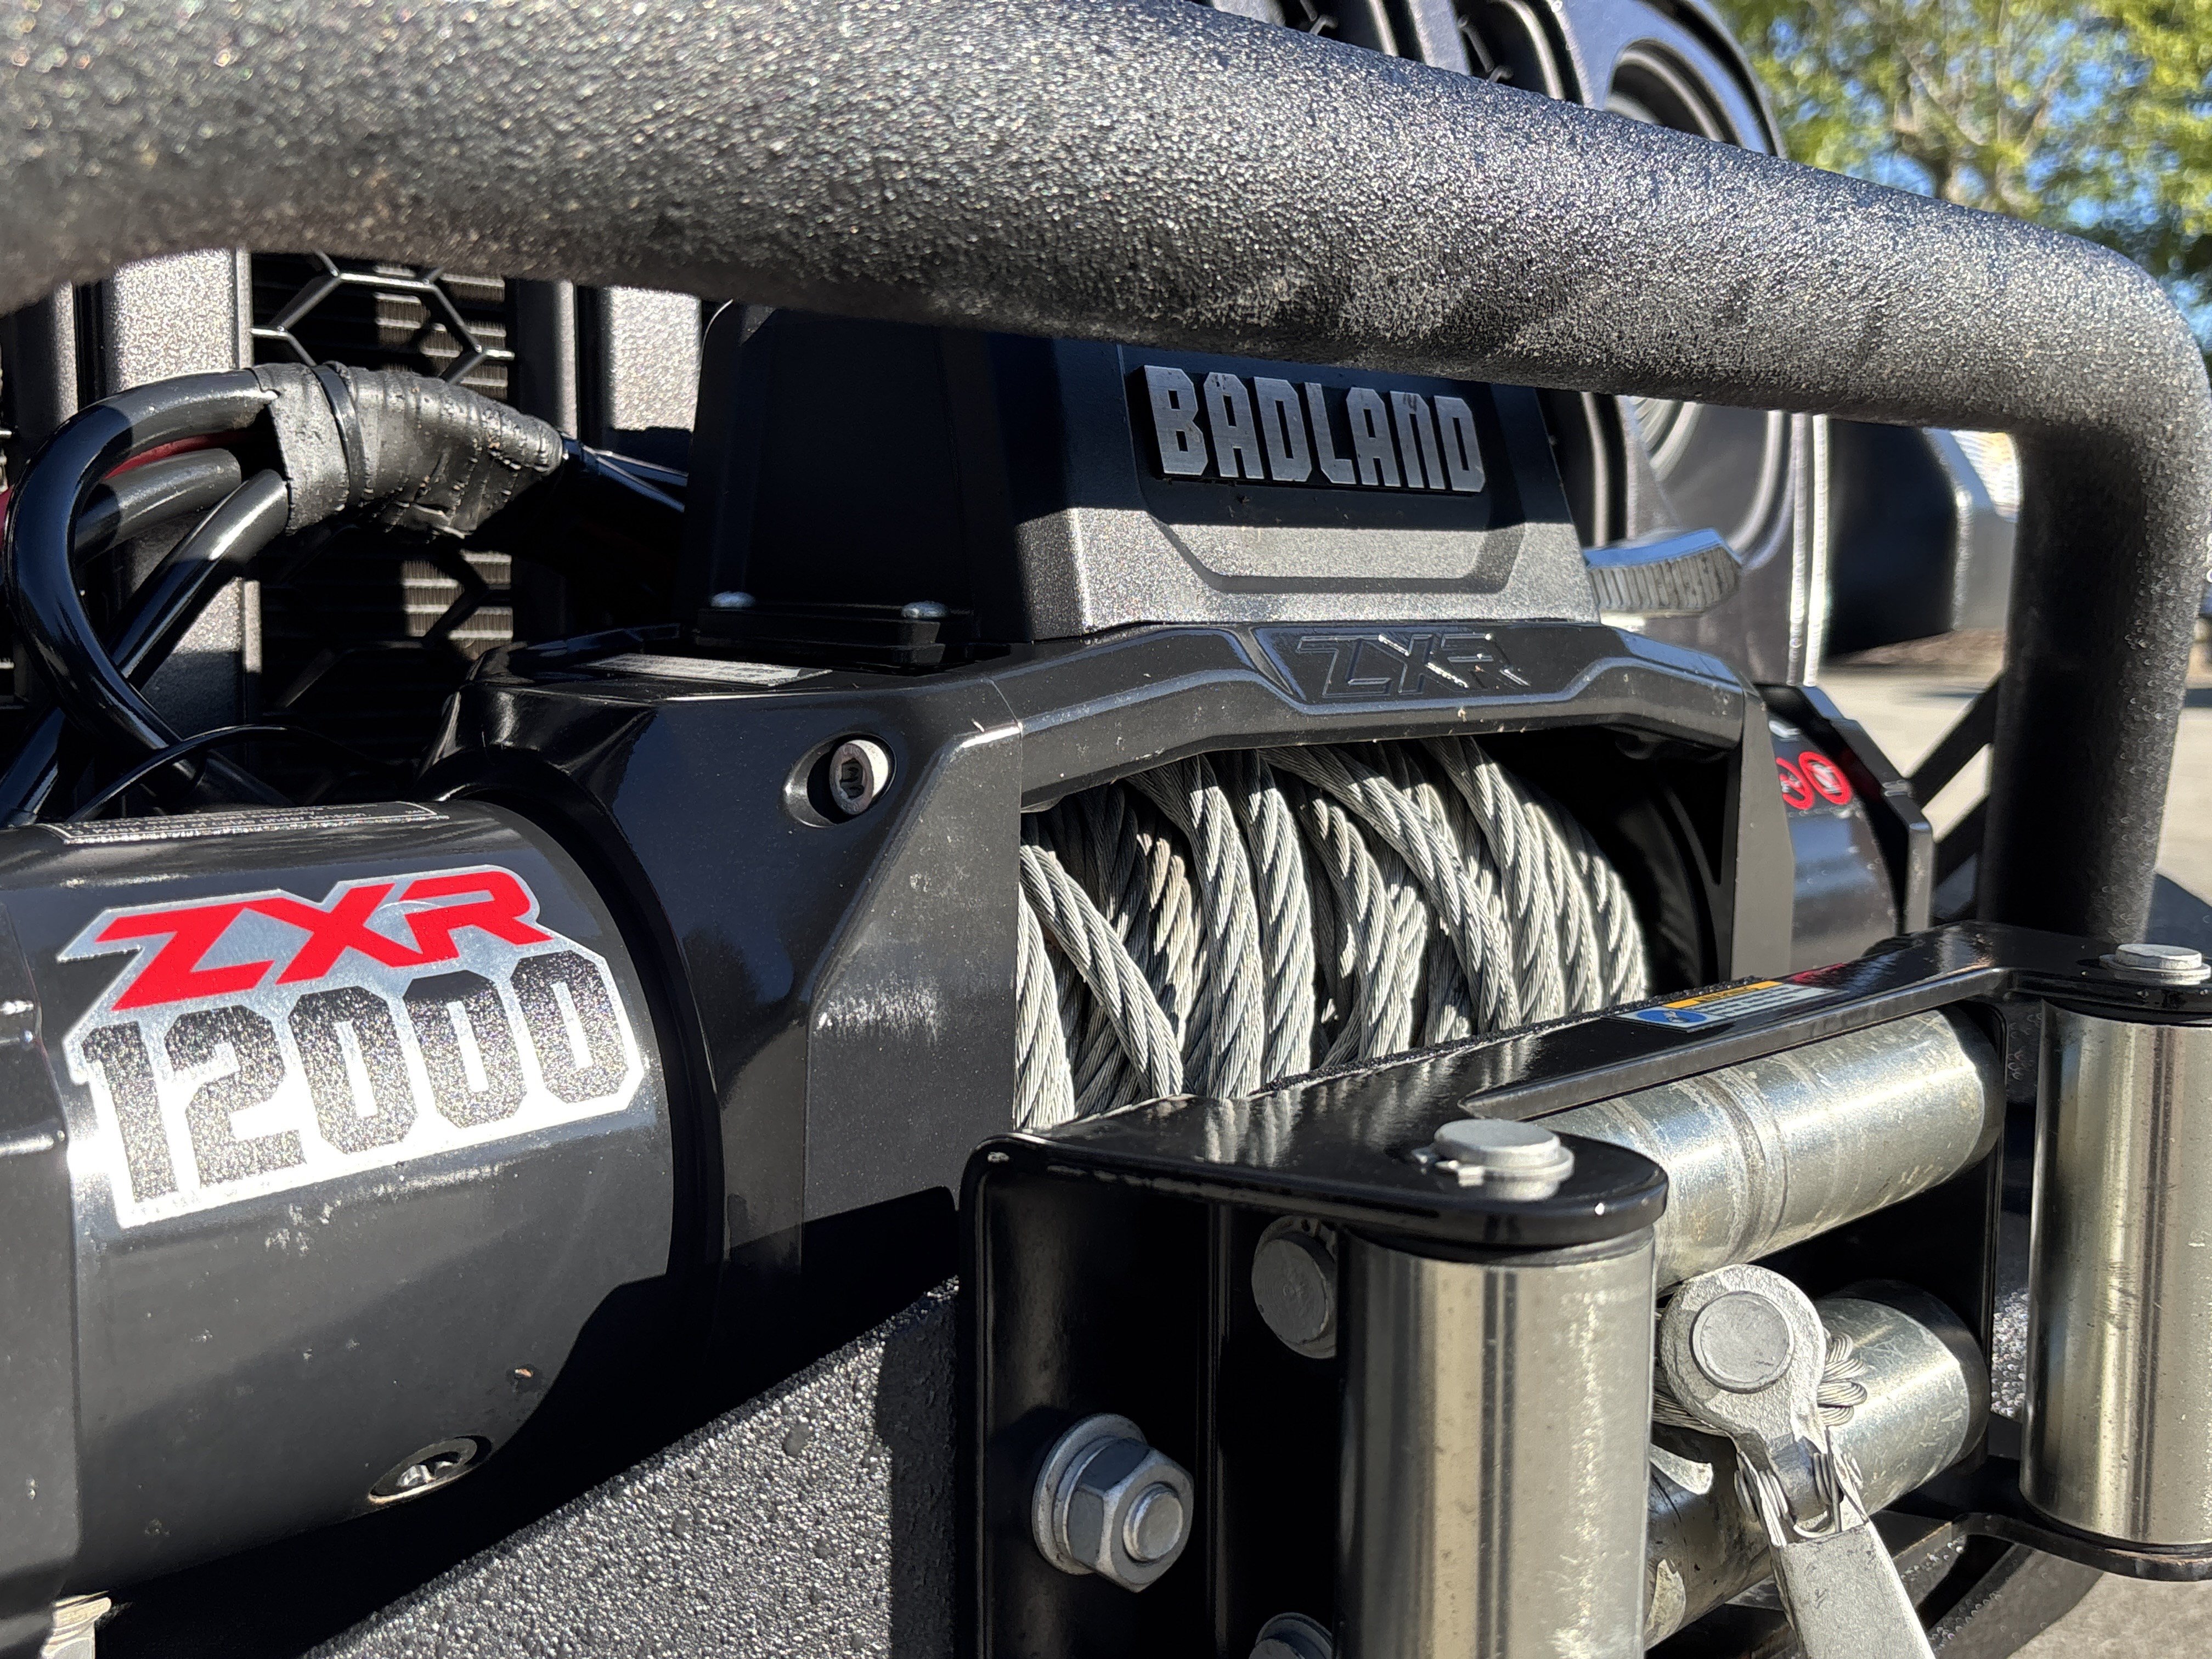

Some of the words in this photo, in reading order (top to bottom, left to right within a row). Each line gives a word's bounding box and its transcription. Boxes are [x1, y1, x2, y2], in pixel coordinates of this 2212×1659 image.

[1144, 364, 1487, 493] BADLAND
[1295, 631, 1532, 699] ZXR
[94, 870, 558, 1012] ZXR
[82, 950, 630, 1202] 12000
